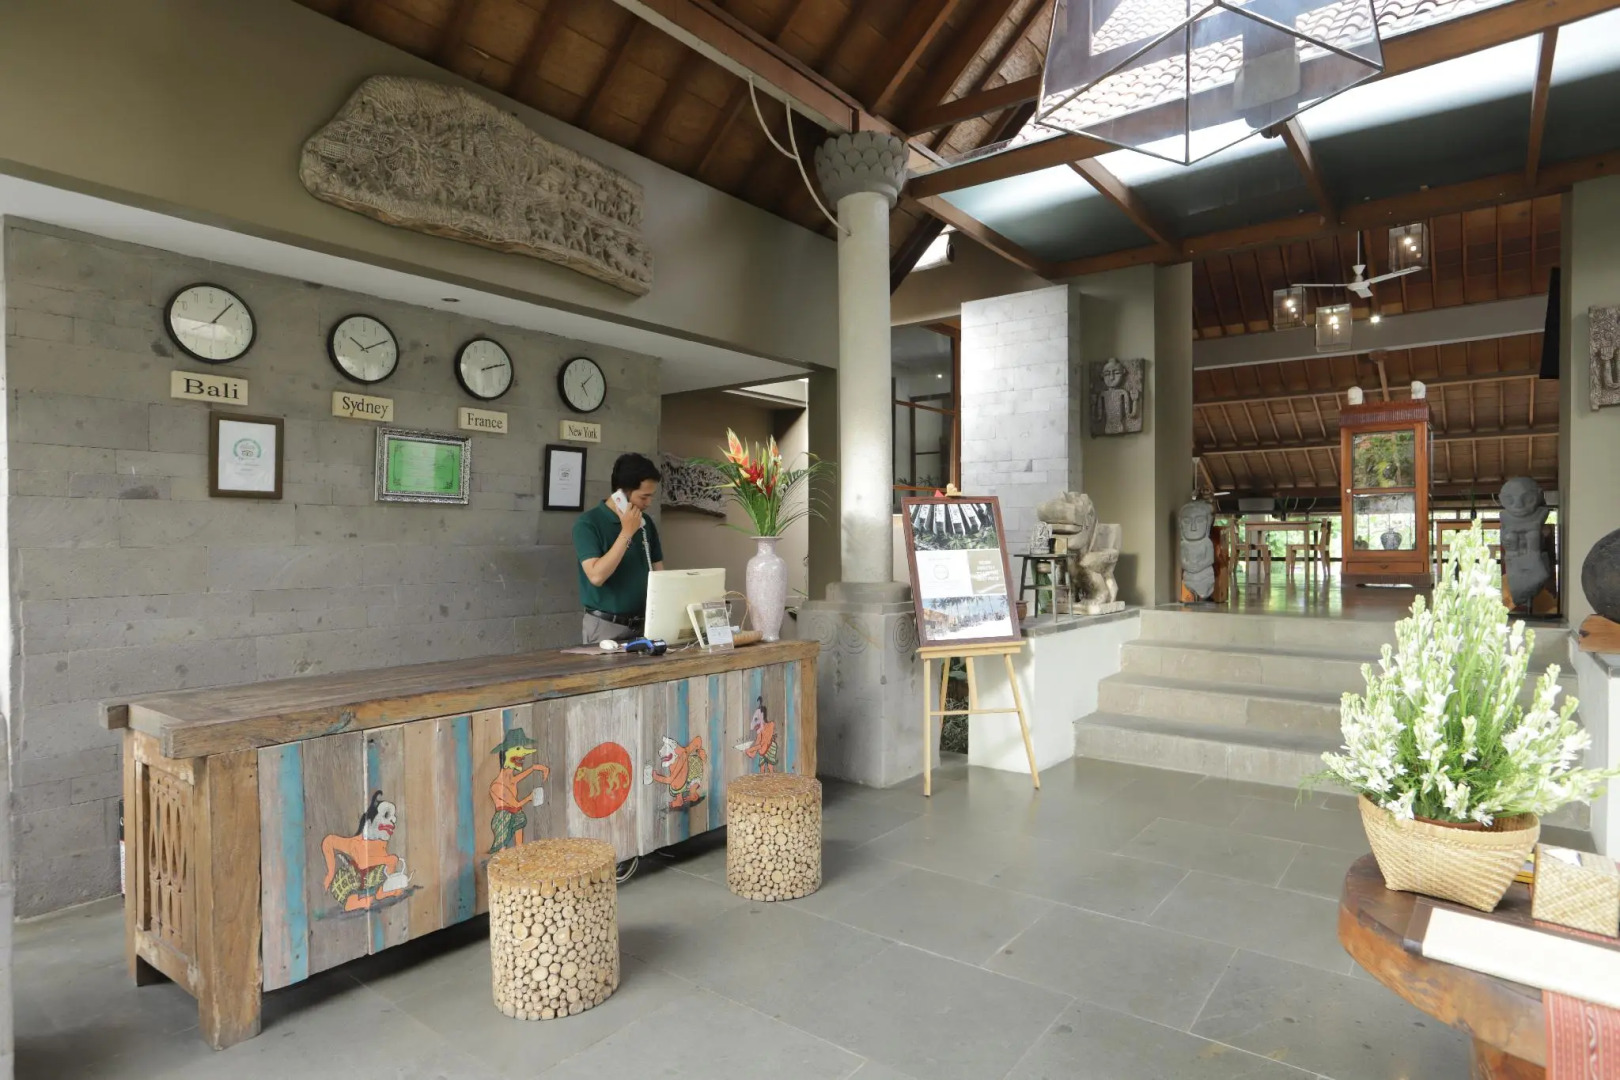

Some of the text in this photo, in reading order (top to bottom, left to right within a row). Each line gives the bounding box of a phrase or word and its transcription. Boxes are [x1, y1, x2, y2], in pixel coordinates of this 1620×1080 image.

[183, 377, 240, 400] Bali
[342, 396, 390, 419] Sydney
[467, 412, 503, 429] France
[568, 424, 598, 439] New York
